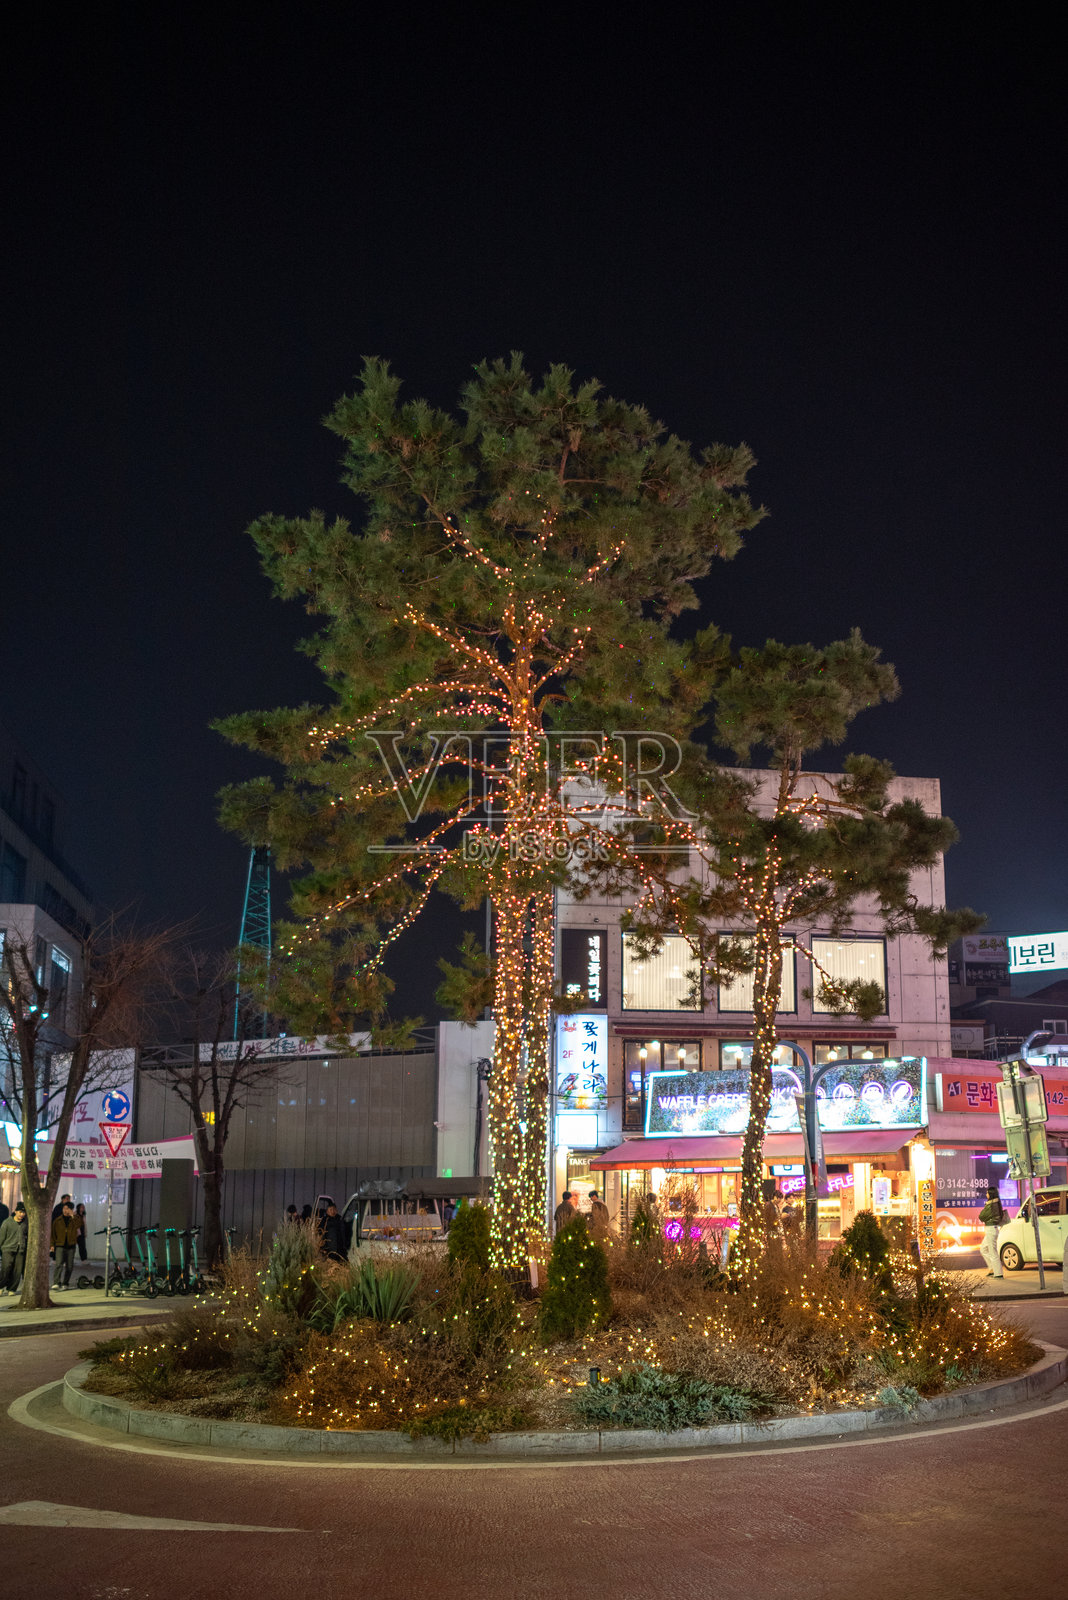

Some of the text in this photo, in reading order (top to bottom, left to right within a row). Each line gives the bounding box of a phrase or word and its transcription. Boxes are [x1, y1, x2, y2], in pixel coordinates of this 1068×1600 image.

[567, 984, 581, 995] 3F
[562, 1050, 574, 1059] 2F
[582, 1021, 600, 1093] 꽃게나라
[658, 1092, 748, 1109] WAFFLE CREPE
[966, 1082, 998, 1107] 문화
[1046, 1091, 1068, 1105] 142-
[568, 1158, 587, 1166] TAKE
[781, 1175, 806, 1194] CREP
[826, 1174, 855, 1192] FFLE
[947, 1178, 989, 1188] 3142-4988
